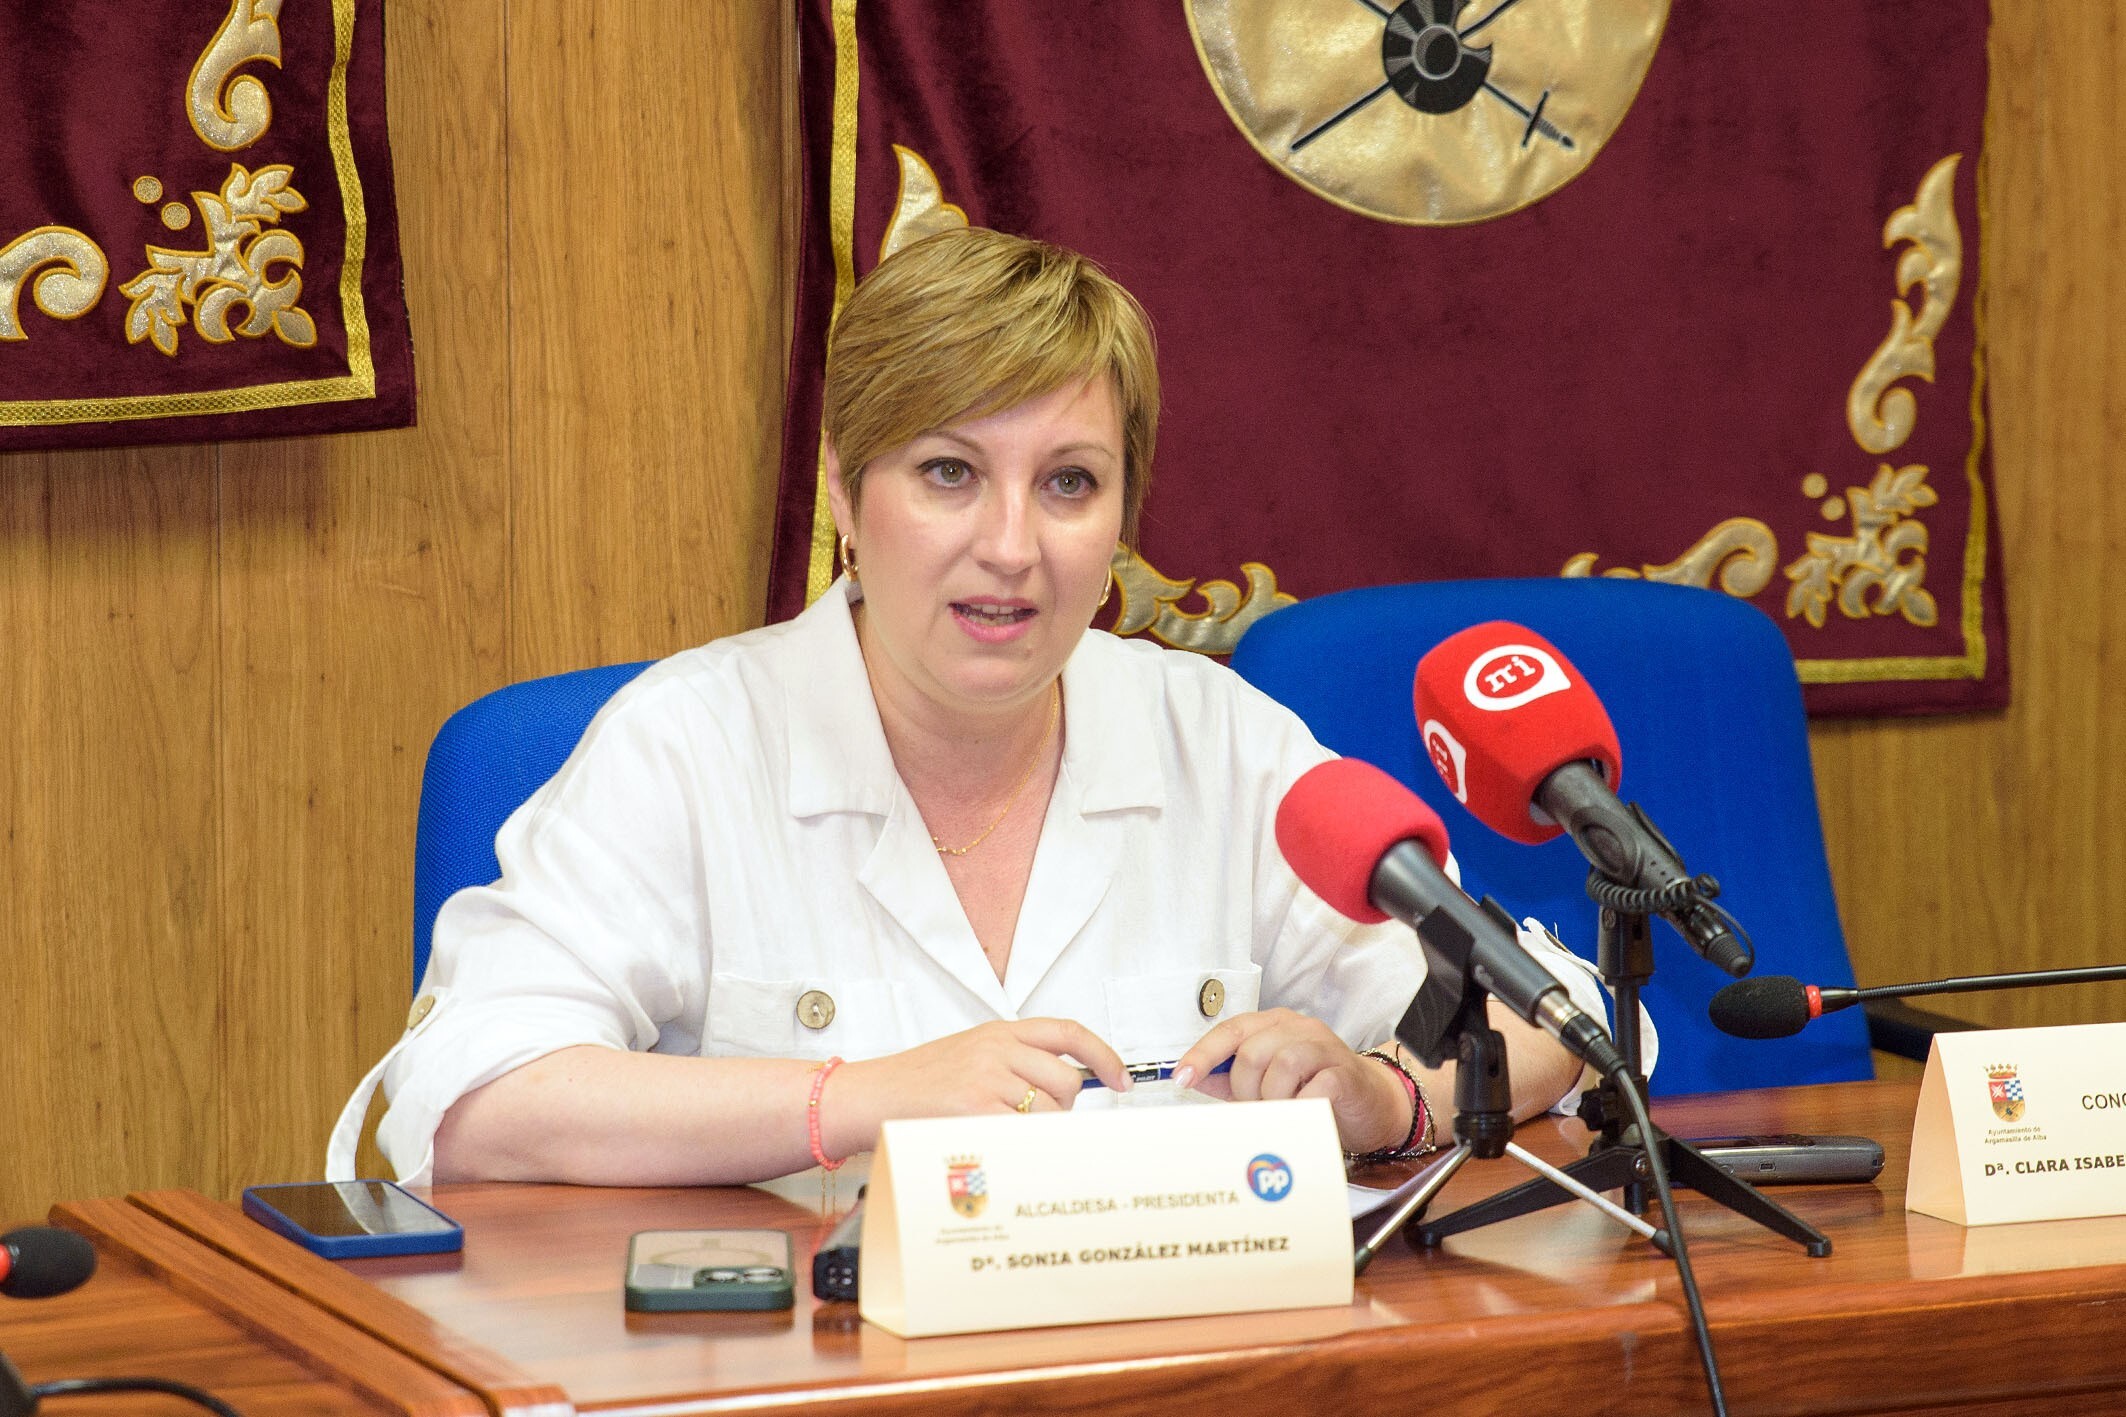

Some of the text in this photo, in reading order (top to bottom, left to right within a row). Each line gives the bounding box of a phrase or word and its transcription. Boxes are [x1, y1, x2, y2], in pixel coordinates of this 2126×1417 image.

[1988, 1127, 2032, 1136] Ayuntamiento
[1984, 1136, 2021, 1145] Argamasilla
[2015, 1158, 2069, 1174] CLARA
[1015, 1199, 1117, 1217] ALCALDESA
[1134, 1191, 1240, 1209] PRESIDENTA
[1008, 1250, 1072, 1269] SONIA
[1079, 1242, 1181, 1263] GONZÁLEZ
[1188, 1234, 1289, 1256] MARTÍNEZ
